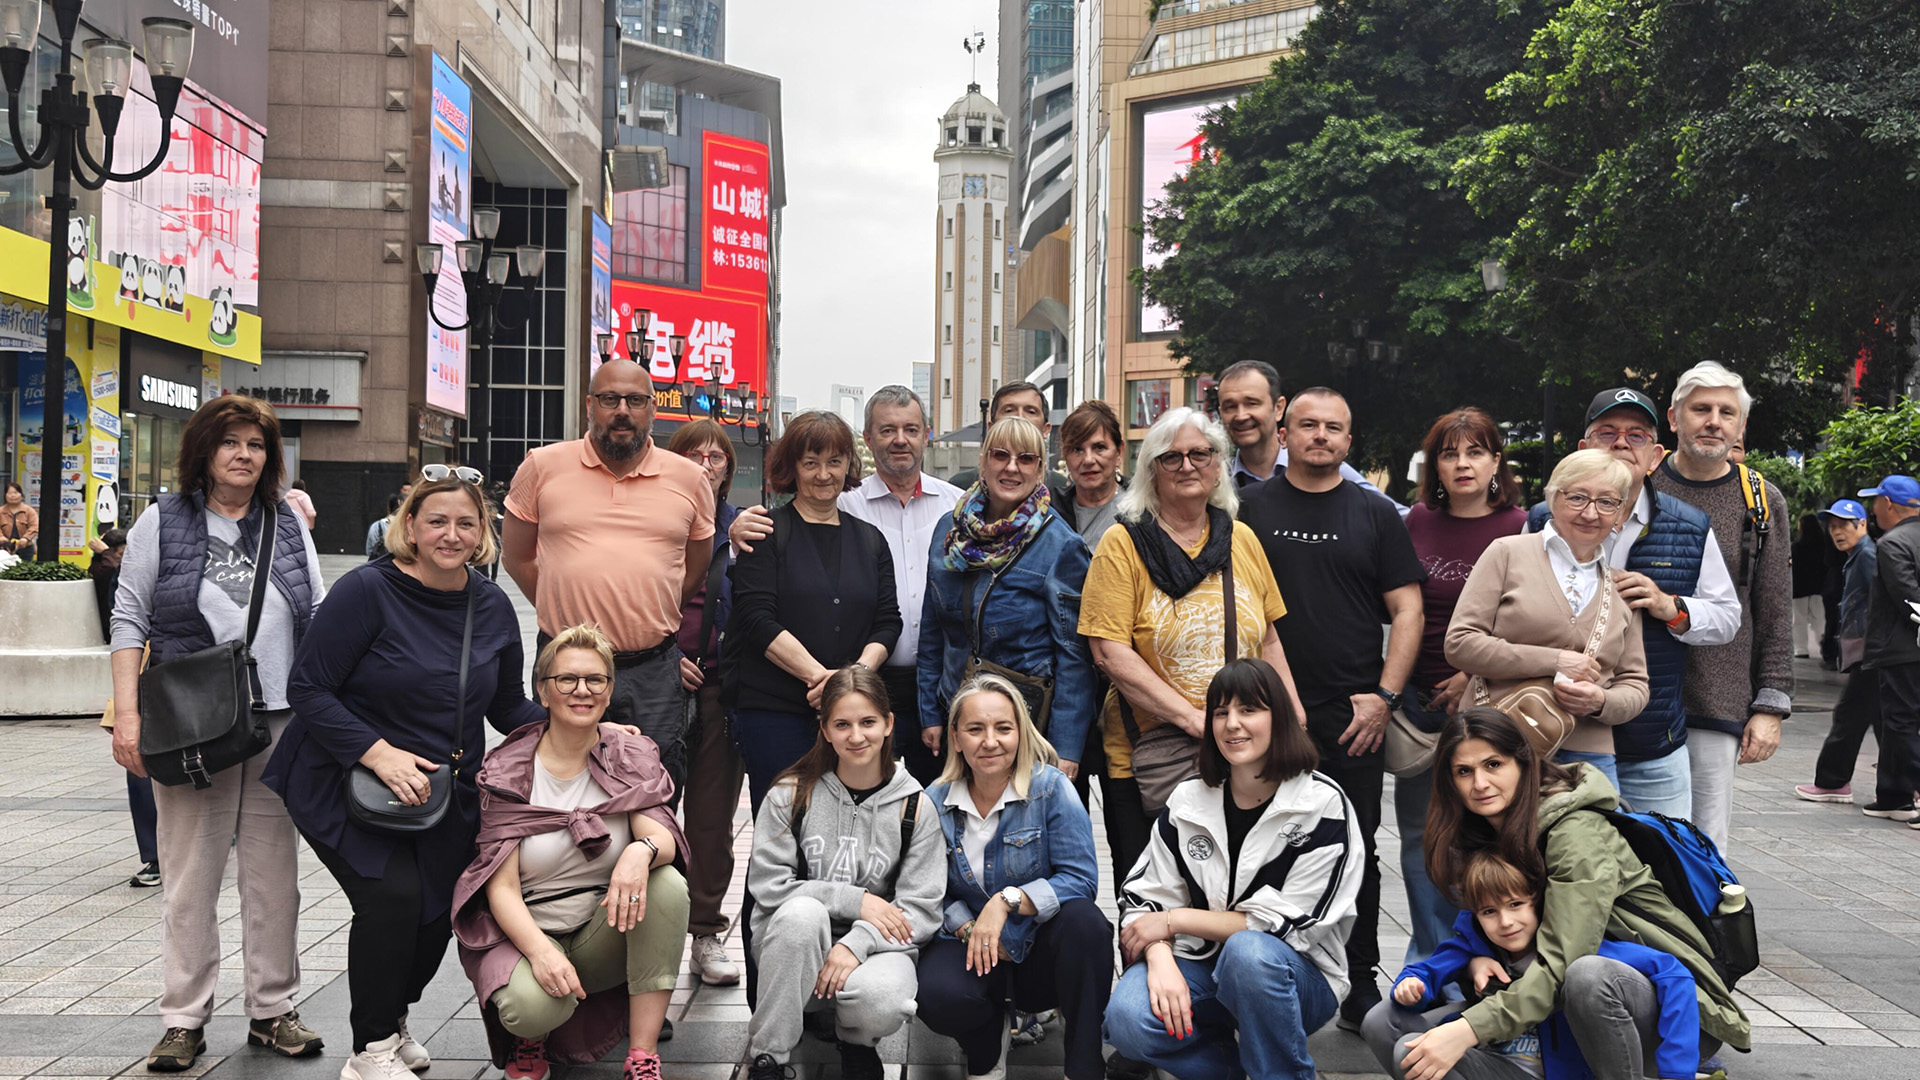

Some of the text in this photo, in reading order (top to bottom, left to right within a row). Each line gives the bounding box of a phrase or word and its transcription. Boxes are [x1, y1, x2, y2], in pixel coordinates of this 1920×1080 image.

[712, 180, 768, 220] 山城
[141, 374, 198, 411] SAMSUNG
[801, 834, 892, 886] GAP
